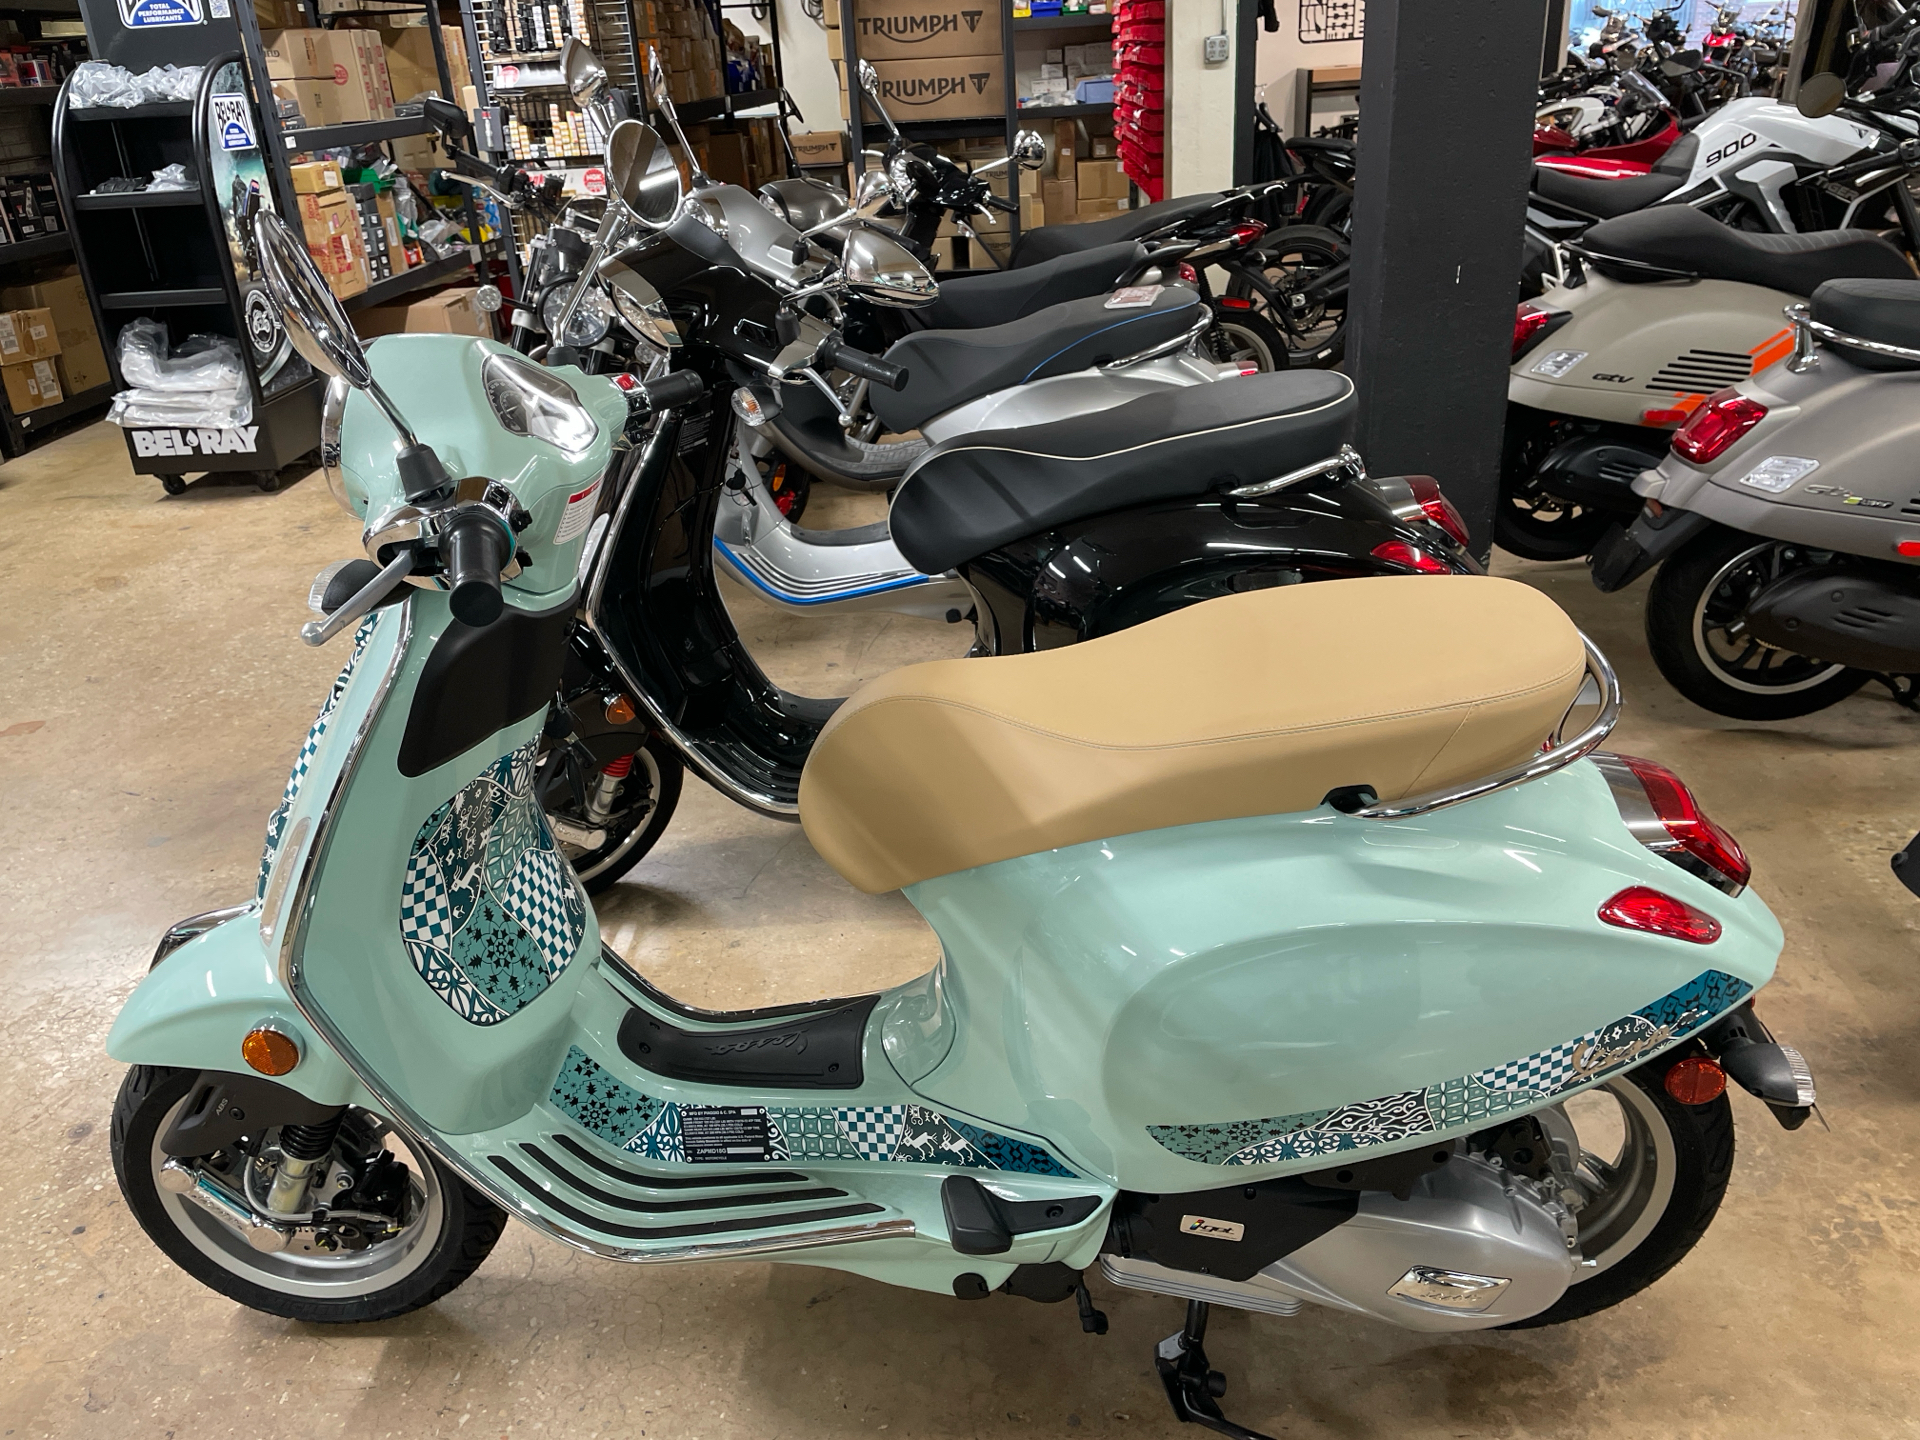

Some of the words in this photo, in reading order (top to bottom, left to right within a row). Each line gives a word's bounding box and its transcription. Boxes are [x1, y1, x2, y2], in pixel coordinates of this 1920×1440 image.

[137, 8, 185, 17] PERFORMANCE
[143, 15, 182, 23] LUBRICANTS
[858, 14, 958, 43] TRIUMPH
[880, 77, 966, 105] RIUMPH
[793, 144, 829, 155] TRIUMPH
[1706, 132, 1757, 168] 900
[1816, 175, 1860, 201] TIGER
[216, 1098, 229, 1116] ABS
